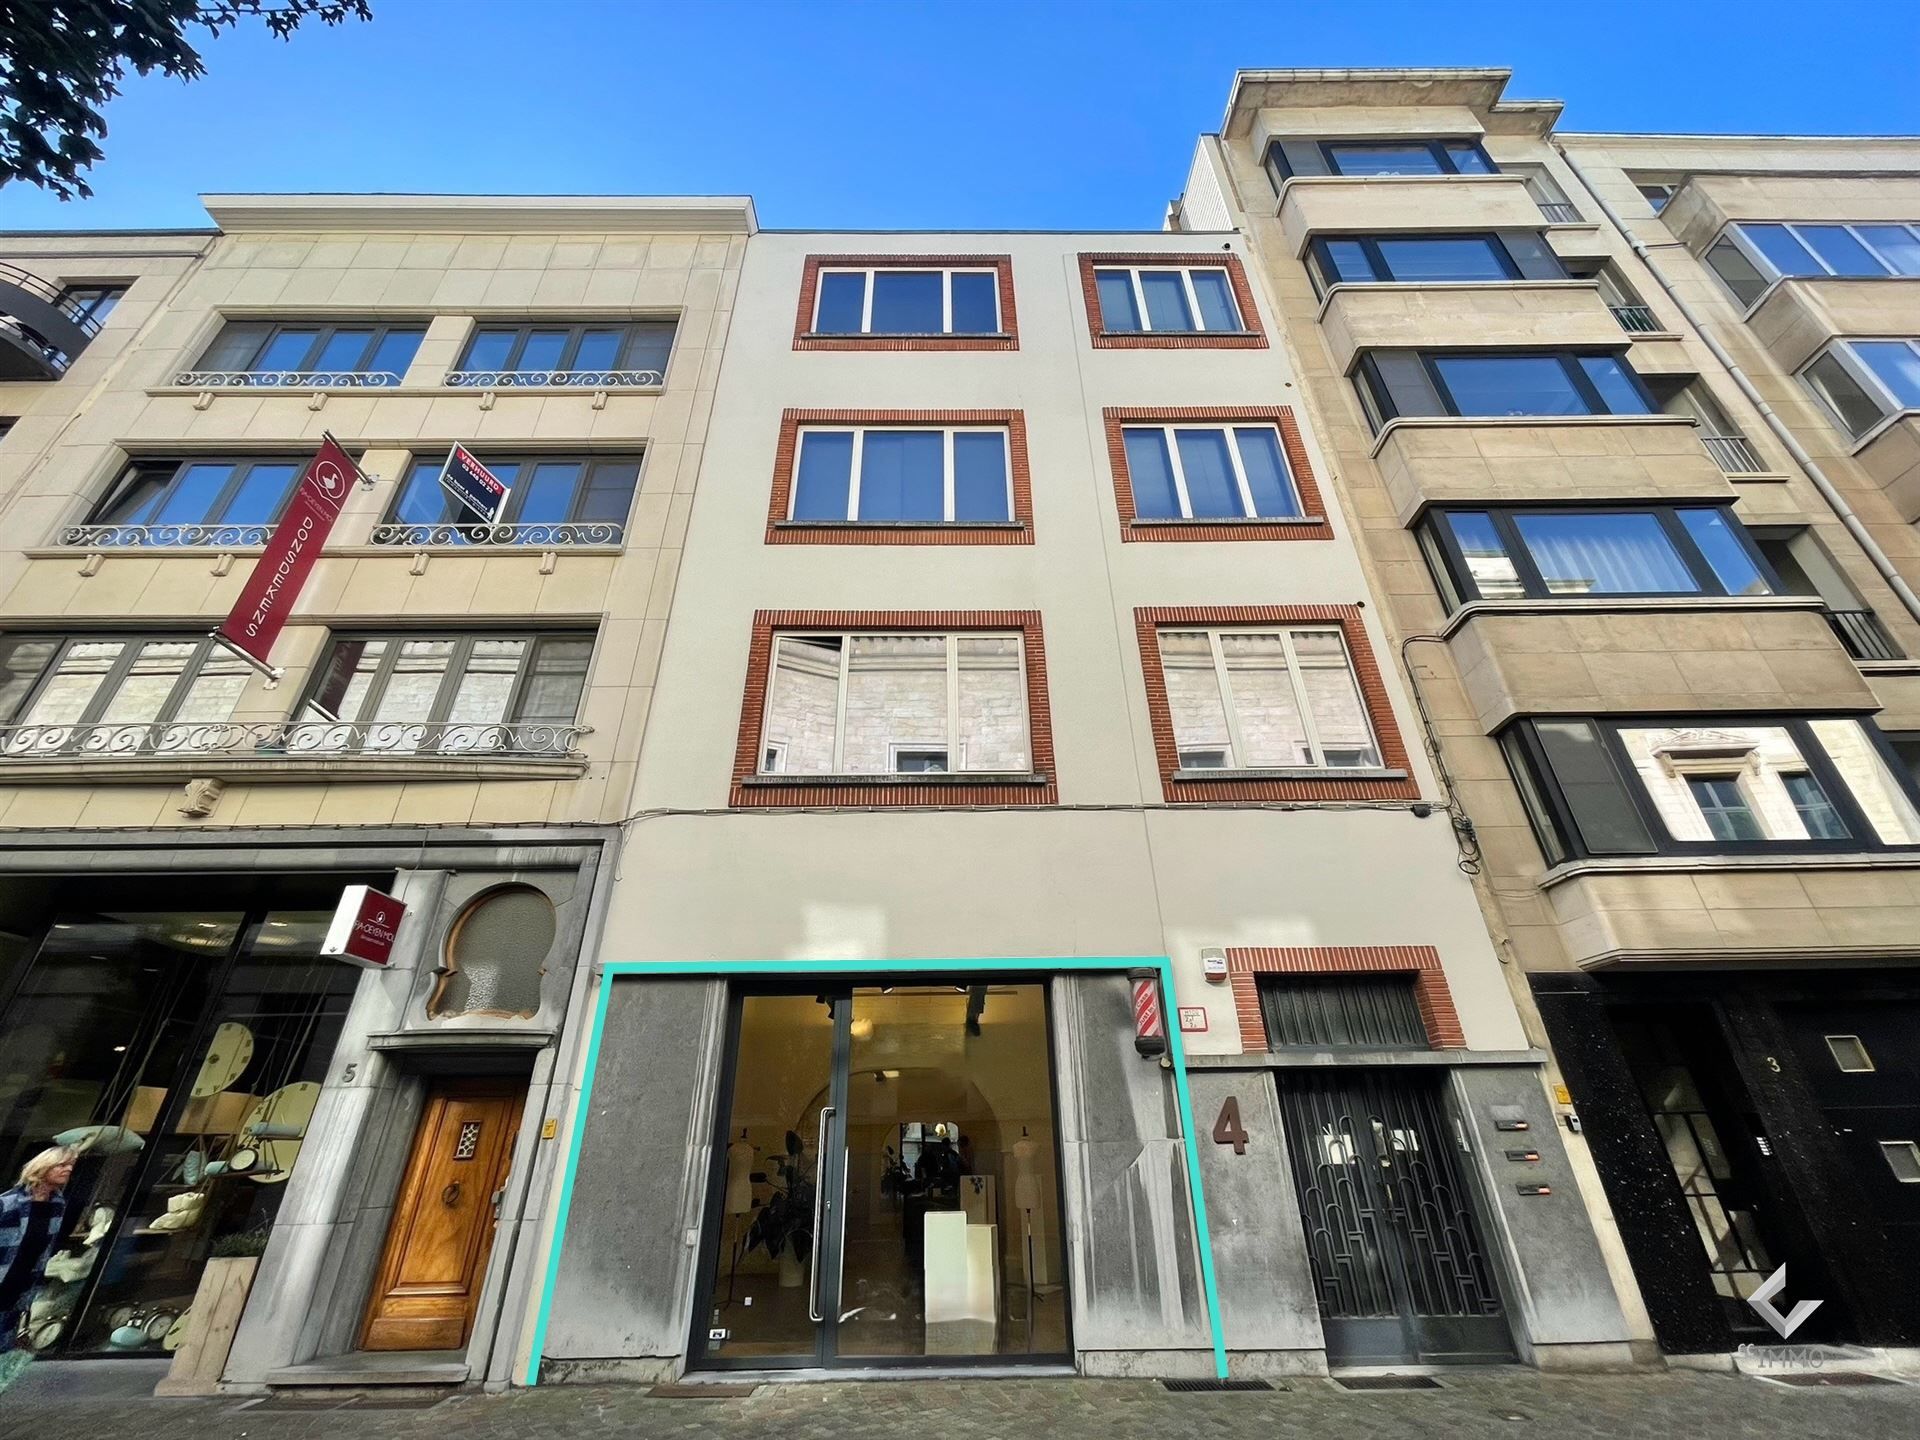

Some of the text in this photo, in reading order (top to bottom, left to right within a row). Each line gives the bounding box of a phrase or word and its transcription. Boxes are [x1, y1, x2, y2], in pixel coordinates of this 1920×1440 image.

[461, 452, 499, 490] VERHUURD
[245, 516, 313, 637] DONSDEKENS
[341, 1063, 358, 1083] 5
[1766, 1056, 1781, 1073] 3
[1212, 1095, 1250, 1156] 4
